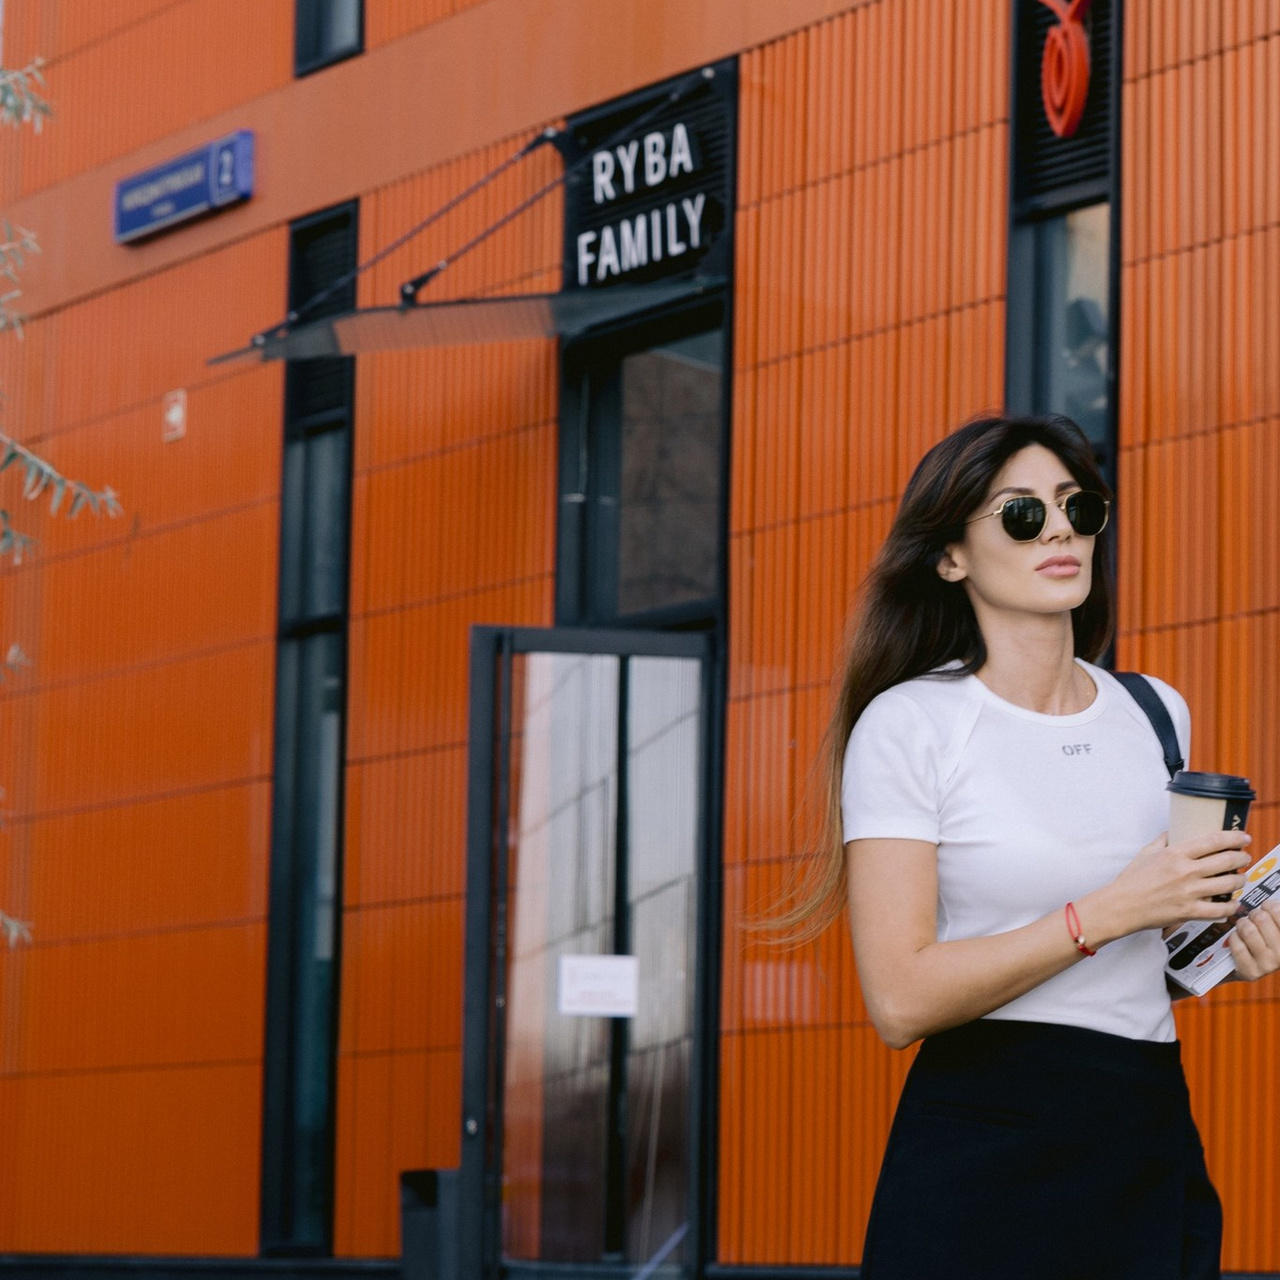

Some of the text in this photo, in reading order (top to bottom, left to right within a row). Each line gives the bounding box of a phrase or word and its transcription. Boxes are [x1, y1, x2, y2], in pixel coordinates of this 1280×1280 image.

[593, 123, 693, 204] RYBA
[577, 193, 706, 286] FAMILY
[1062, 743, 1092, 756] OFF
